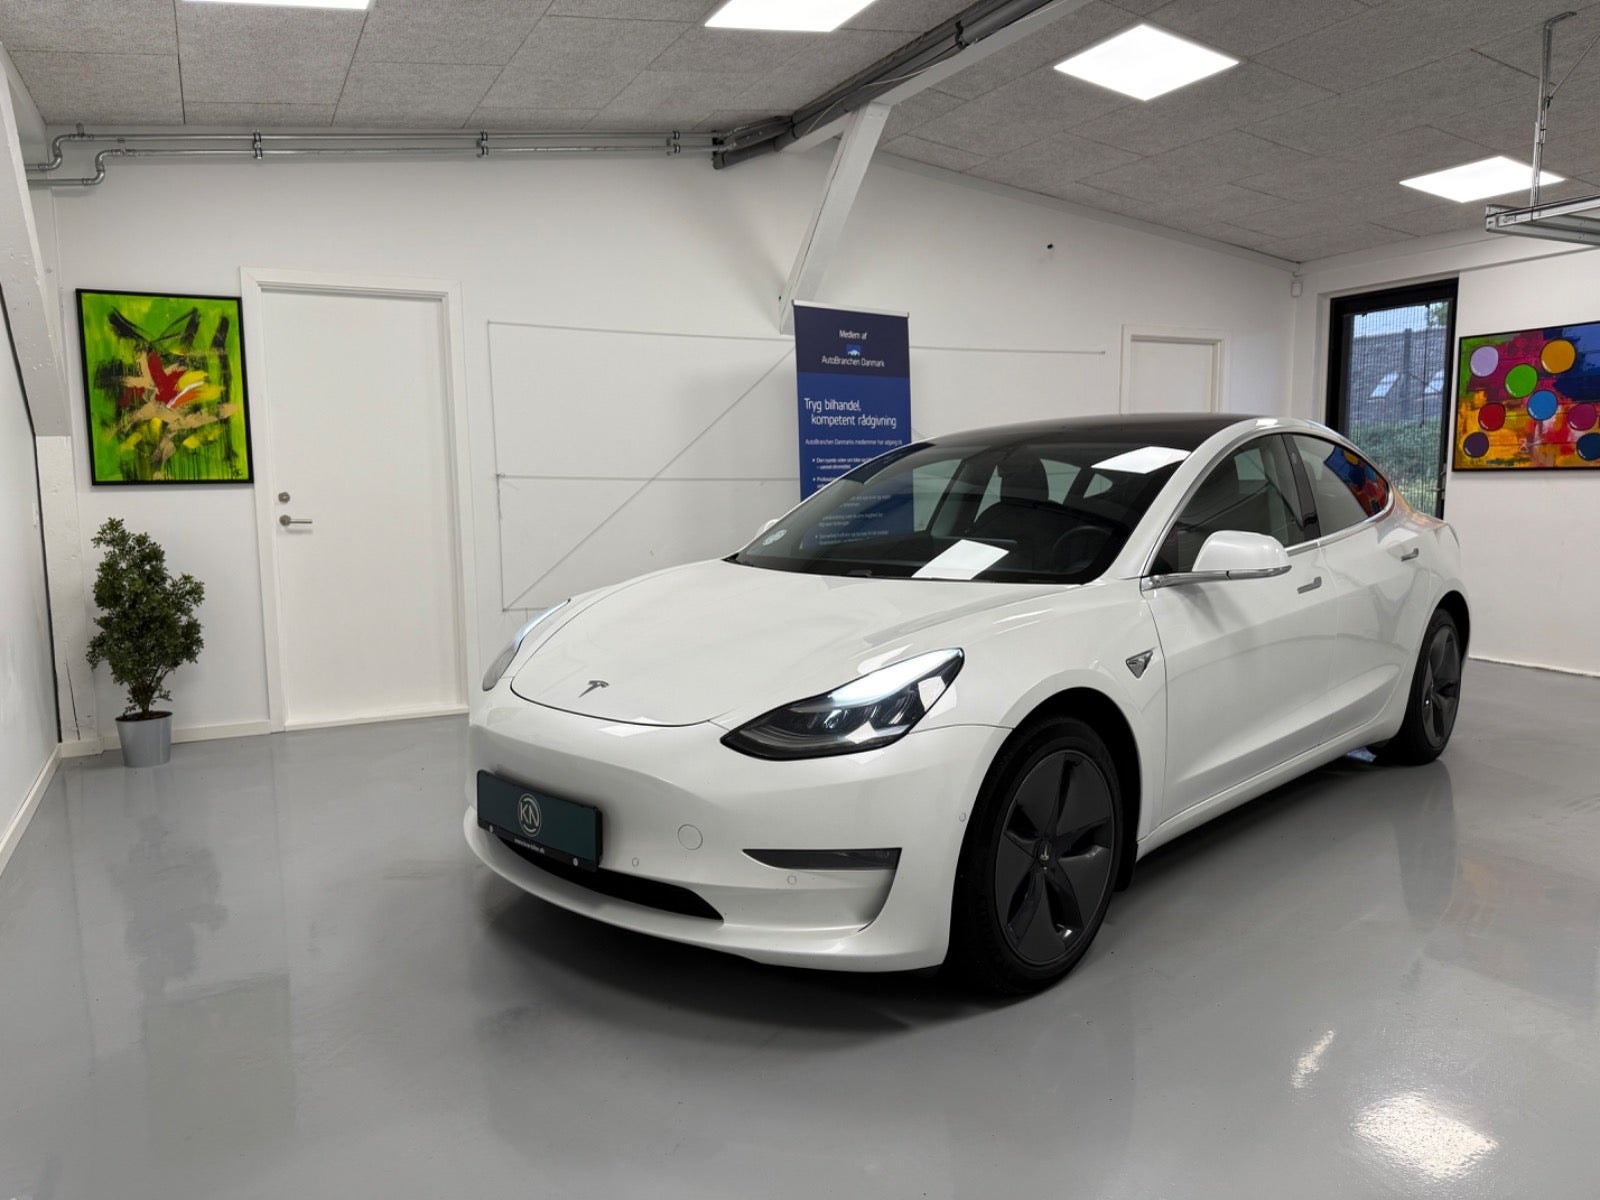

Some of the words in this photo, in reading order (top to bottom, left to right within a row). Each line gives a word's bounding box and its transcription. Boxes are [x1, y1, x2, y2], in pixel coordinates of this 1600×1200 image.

[839, 330, 860, 340] Medlem
[861, 332, 868, 340] af
[821, 355, 860, 366] AutoBranchen
[861, 358, 885, 367] Danmark
[803, 397, 822, 413] Tryg
[824, 398, 862, 411] bilhandel,
[811, 414, 856, 427] kompetent
[858, 414, 897, 429] rådgivning
[520, 798, 540, 828] KN
